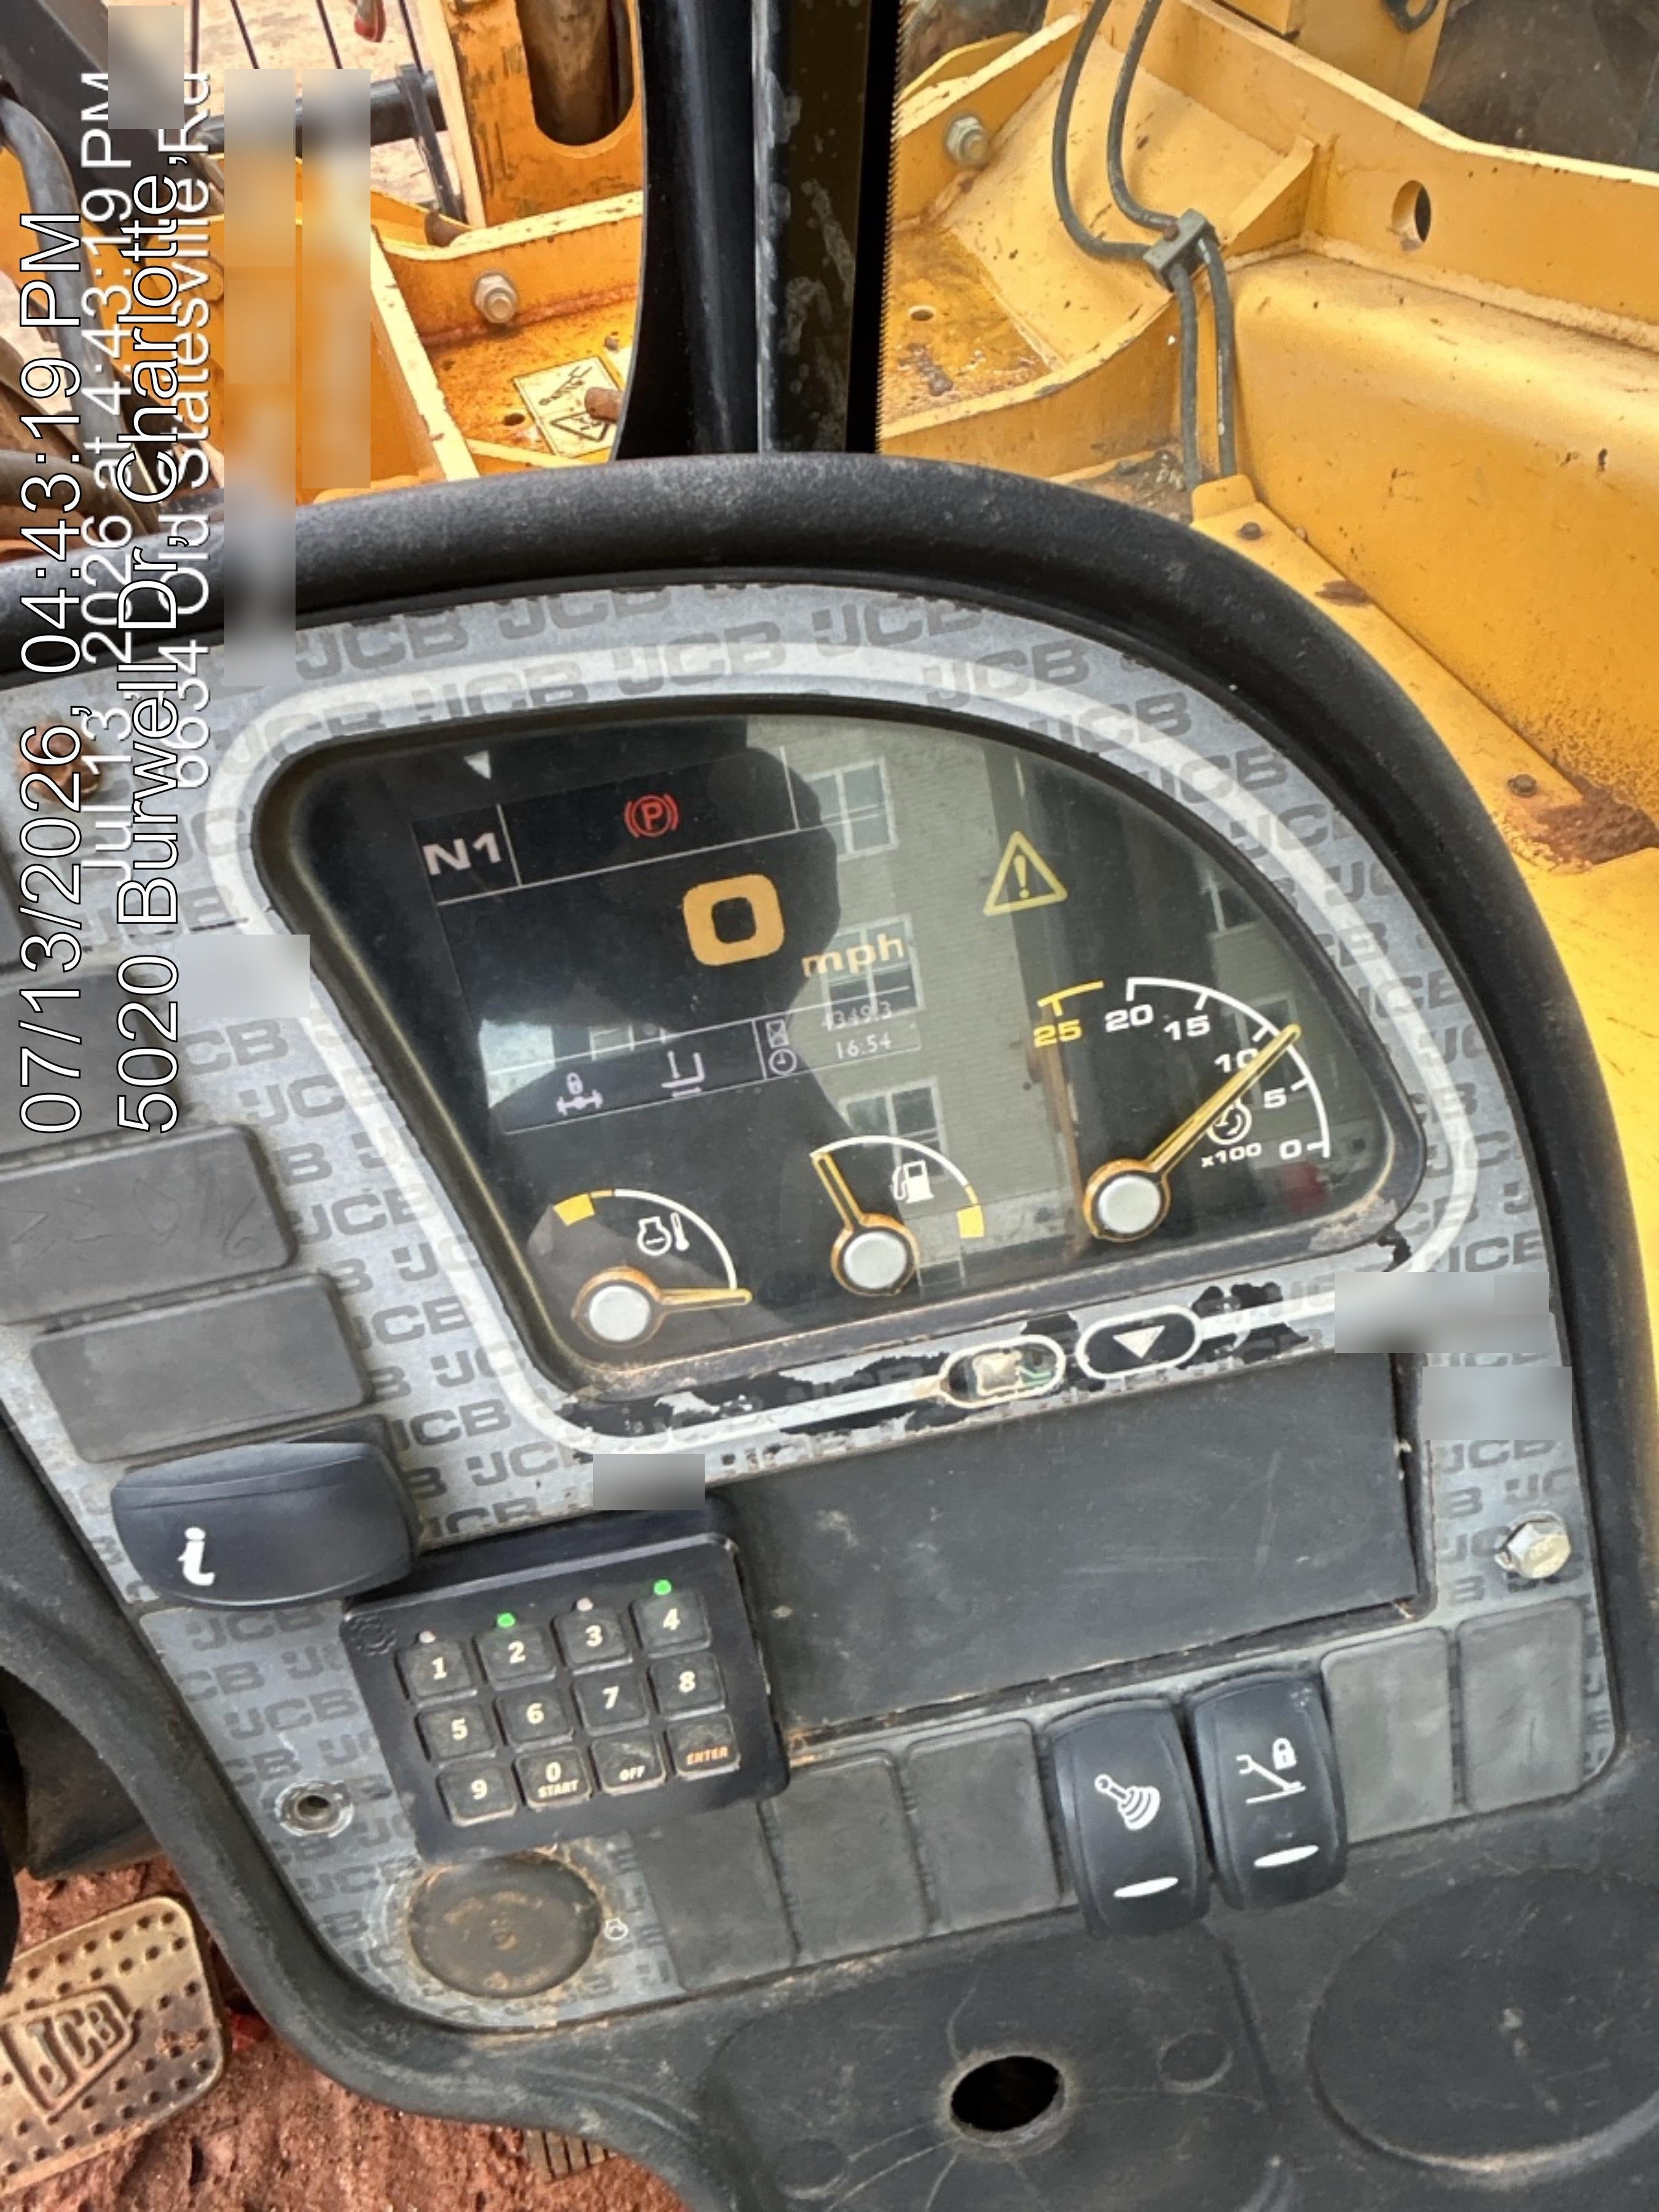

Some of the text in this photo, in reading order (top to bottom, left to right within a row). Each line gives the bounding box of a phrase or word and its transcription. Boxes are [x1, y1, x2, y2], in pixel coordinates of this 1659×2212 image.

[296, 611, 468, 680] JCB
[612, 621, 786, 695] JCB
[922, 639, 1090, 709] JCB
[422, 831, 502, 876] N1
[801, 933, 904, 978] mph
[1104, 1004, 1154, 1032] 20
[1164, 1015, 1211, 1040] 15
[1033, 1019, 1082, 1047] 25
[1215, 1048, 1260, 1073] 10
[1264, 1088, 1287, 1108] 5
[1201, 1142, 1262, 1167] x100
[1279, 1139, 1301, 1160] 0
[663, 1608, 680, 1631] 4
[586, 1625, 602, 1647] 3
[509, 1642, 526, 1663] 2
[432, 1657, 447, 1679] 1
[679, 1671, 696, 1693] 8
[603, 1686, 619, 1709] 7
[224, 1689, 359, 1739] JCB
[527, 1703, 544, 1724] 6
[452, 1719, 468, 1741] 5
[686, 1746, 728, 1765] ENTER
[546, 1762, 561, 1782] 0
[619, 1765, 645, 1782] OFF
[471, 1779, 487, 1800] 9
[538, 1779, 579, 1798] START
[25, 2001, 117, 2096] JCB
